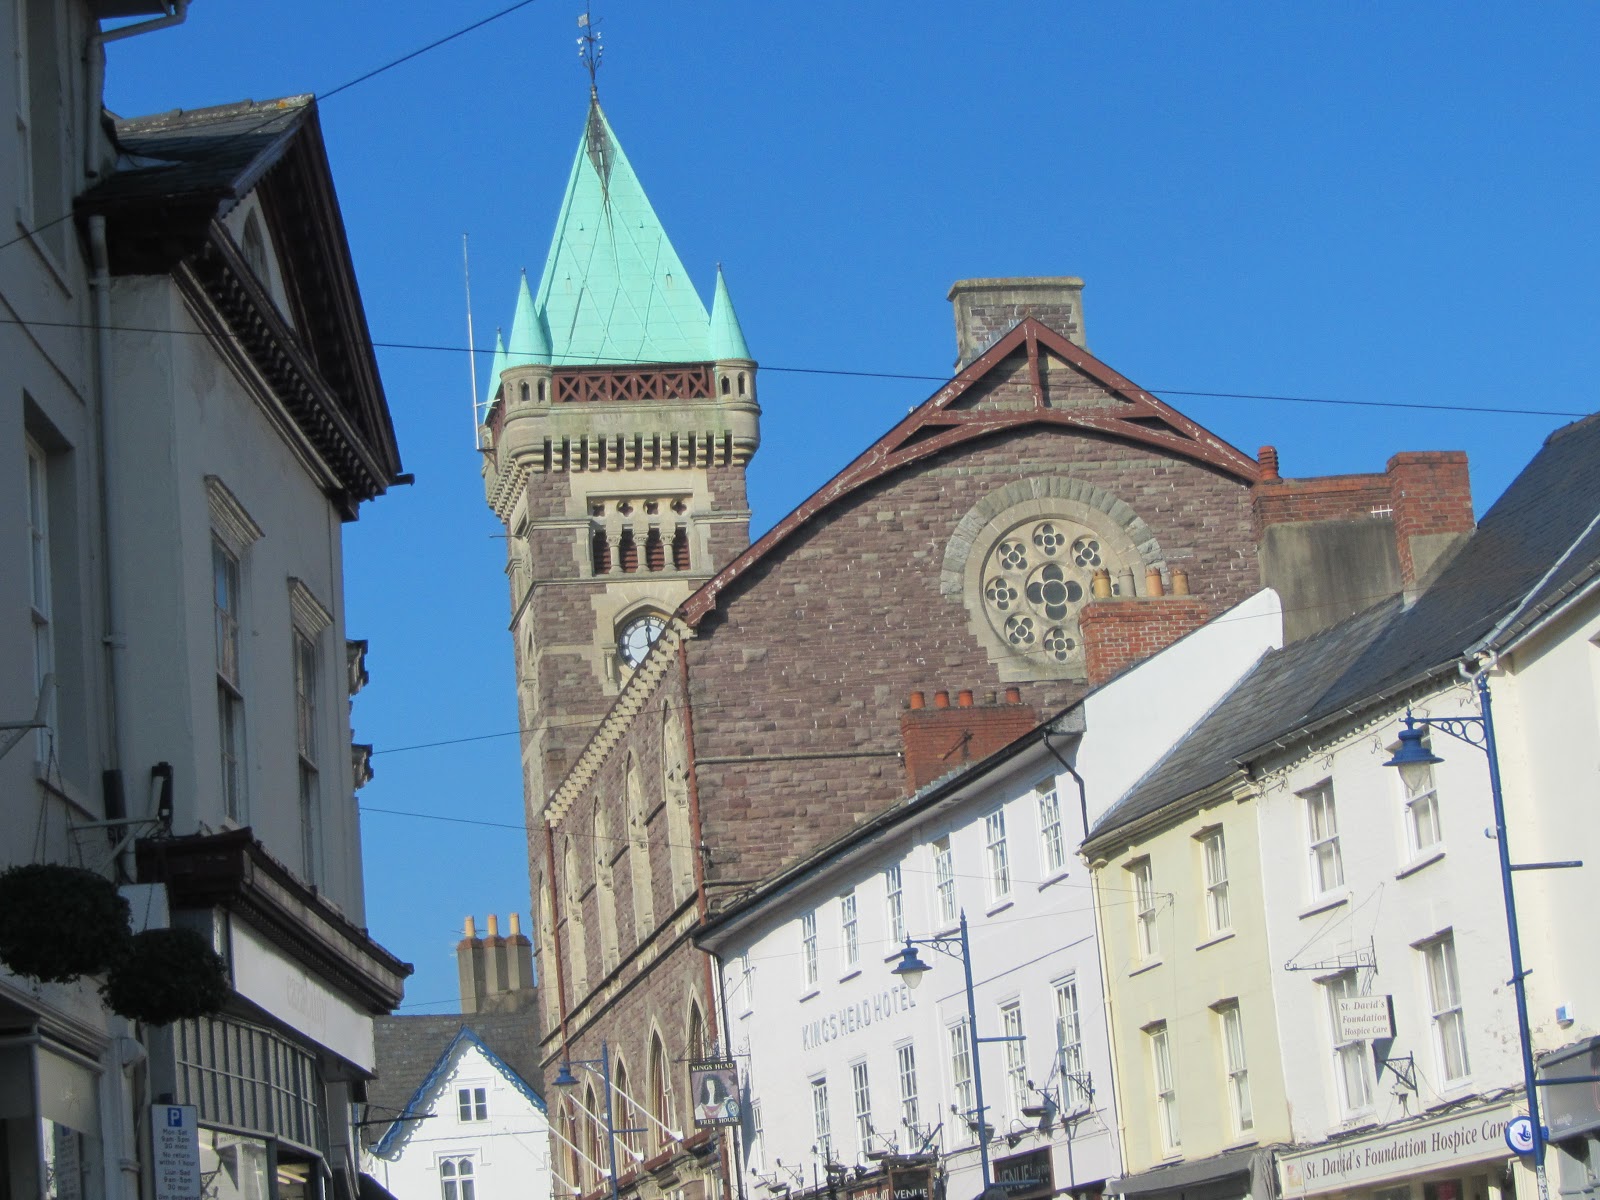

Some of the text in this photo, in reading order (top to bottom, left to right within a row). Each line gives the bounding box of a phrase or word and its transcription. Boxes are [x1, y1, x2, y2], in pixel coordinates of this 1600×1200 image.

[1340, 1000, 1385, 1011] St. David's
[802, 983, 917, 1051] KINGS HEAD HOTEL
[1342, 1013, 1387, 1024] Foundation
[1344, 1025, 1388, 1036] Hospice Care
[692, 1064, 713, 1072] KINGS
[1306, 1161, 1319, 1180] St.
[1322, 1149, 1361, 1177] David's
[1365, 1137, 1427, 1167] Foundation
[1431, 1126, 1478, 1153] Hospice
[893, 1188, 929, 1199] VENUE
